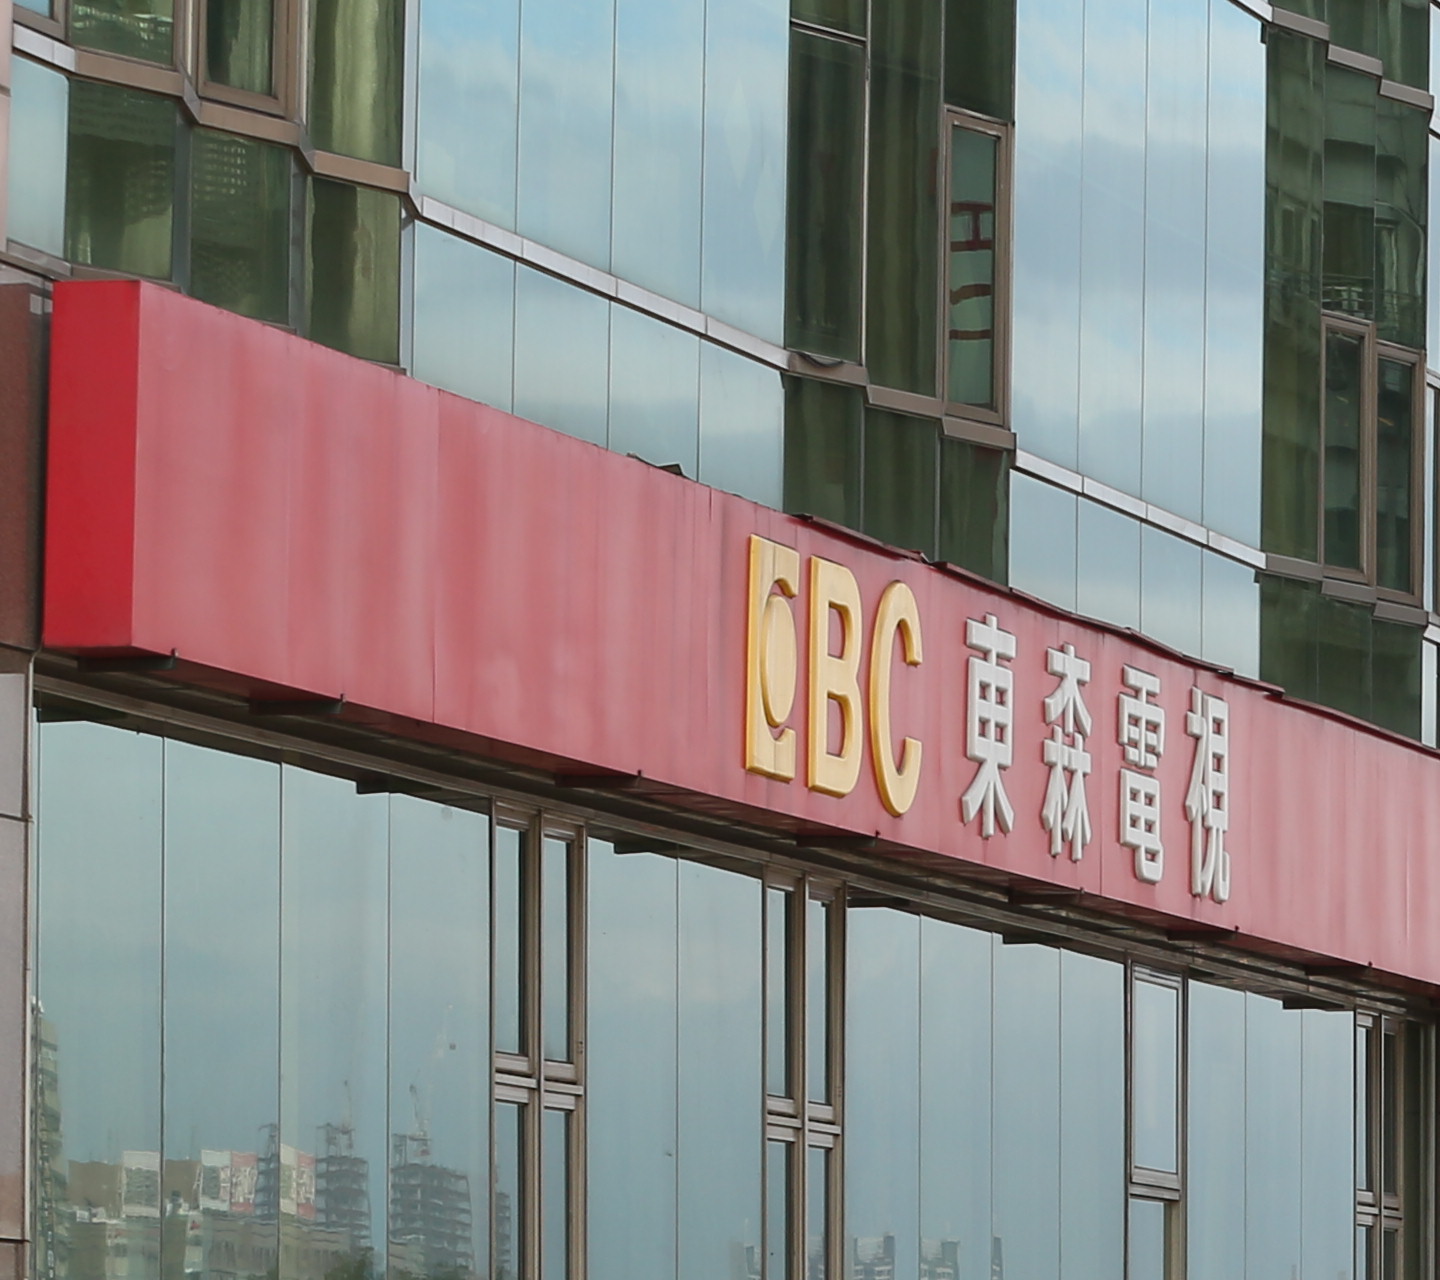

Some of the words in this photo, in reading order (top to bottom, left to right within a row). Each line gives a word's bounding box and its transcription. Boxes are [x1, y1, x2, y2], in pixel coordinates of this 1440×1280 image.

[746, 533, 922, 818] EBC
[961, 611, 1230, 903] 東森電視
